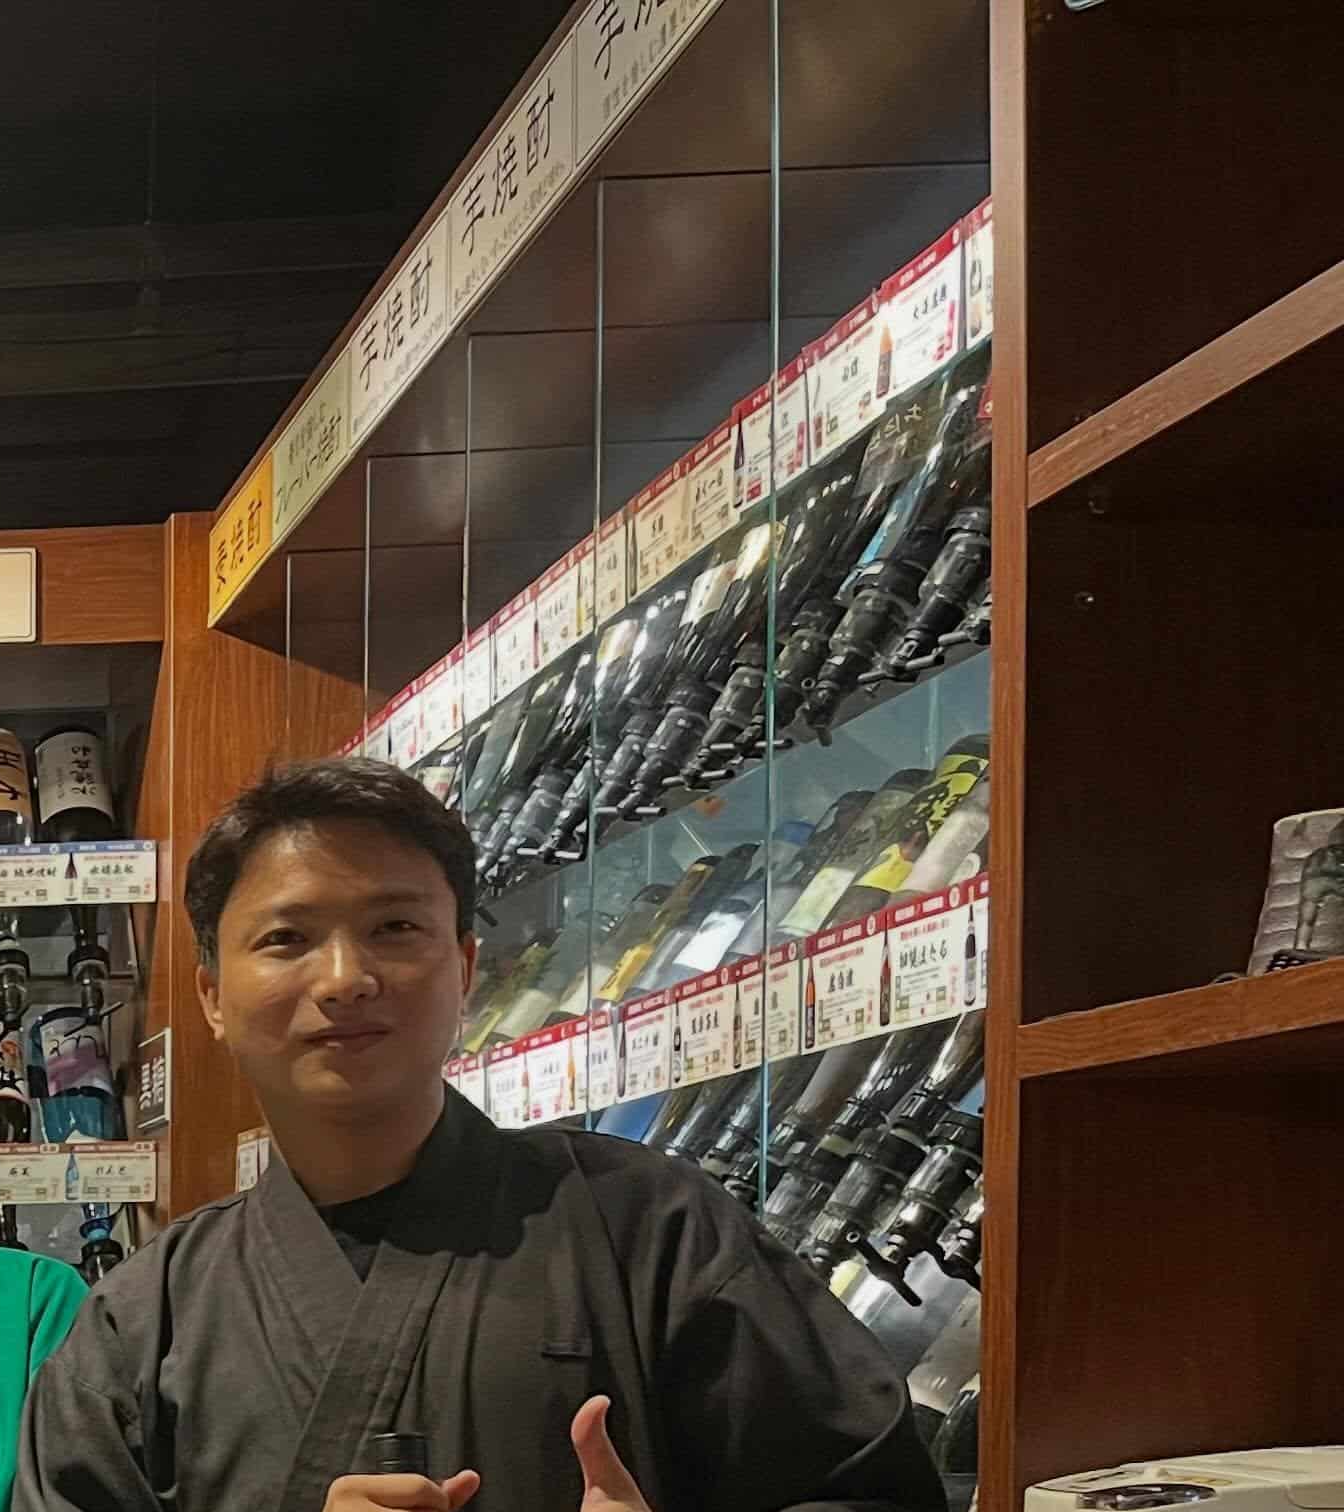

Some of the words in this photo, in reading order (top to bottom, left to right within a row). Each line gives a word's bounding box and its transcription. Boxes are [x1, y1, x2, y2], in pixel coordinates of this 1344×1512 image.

[461, 76, 554, 257] 芋焼酎
[360, 246, 432, 391] 芋焼酎
[216, 491, 262, 592] 麦焼酎
